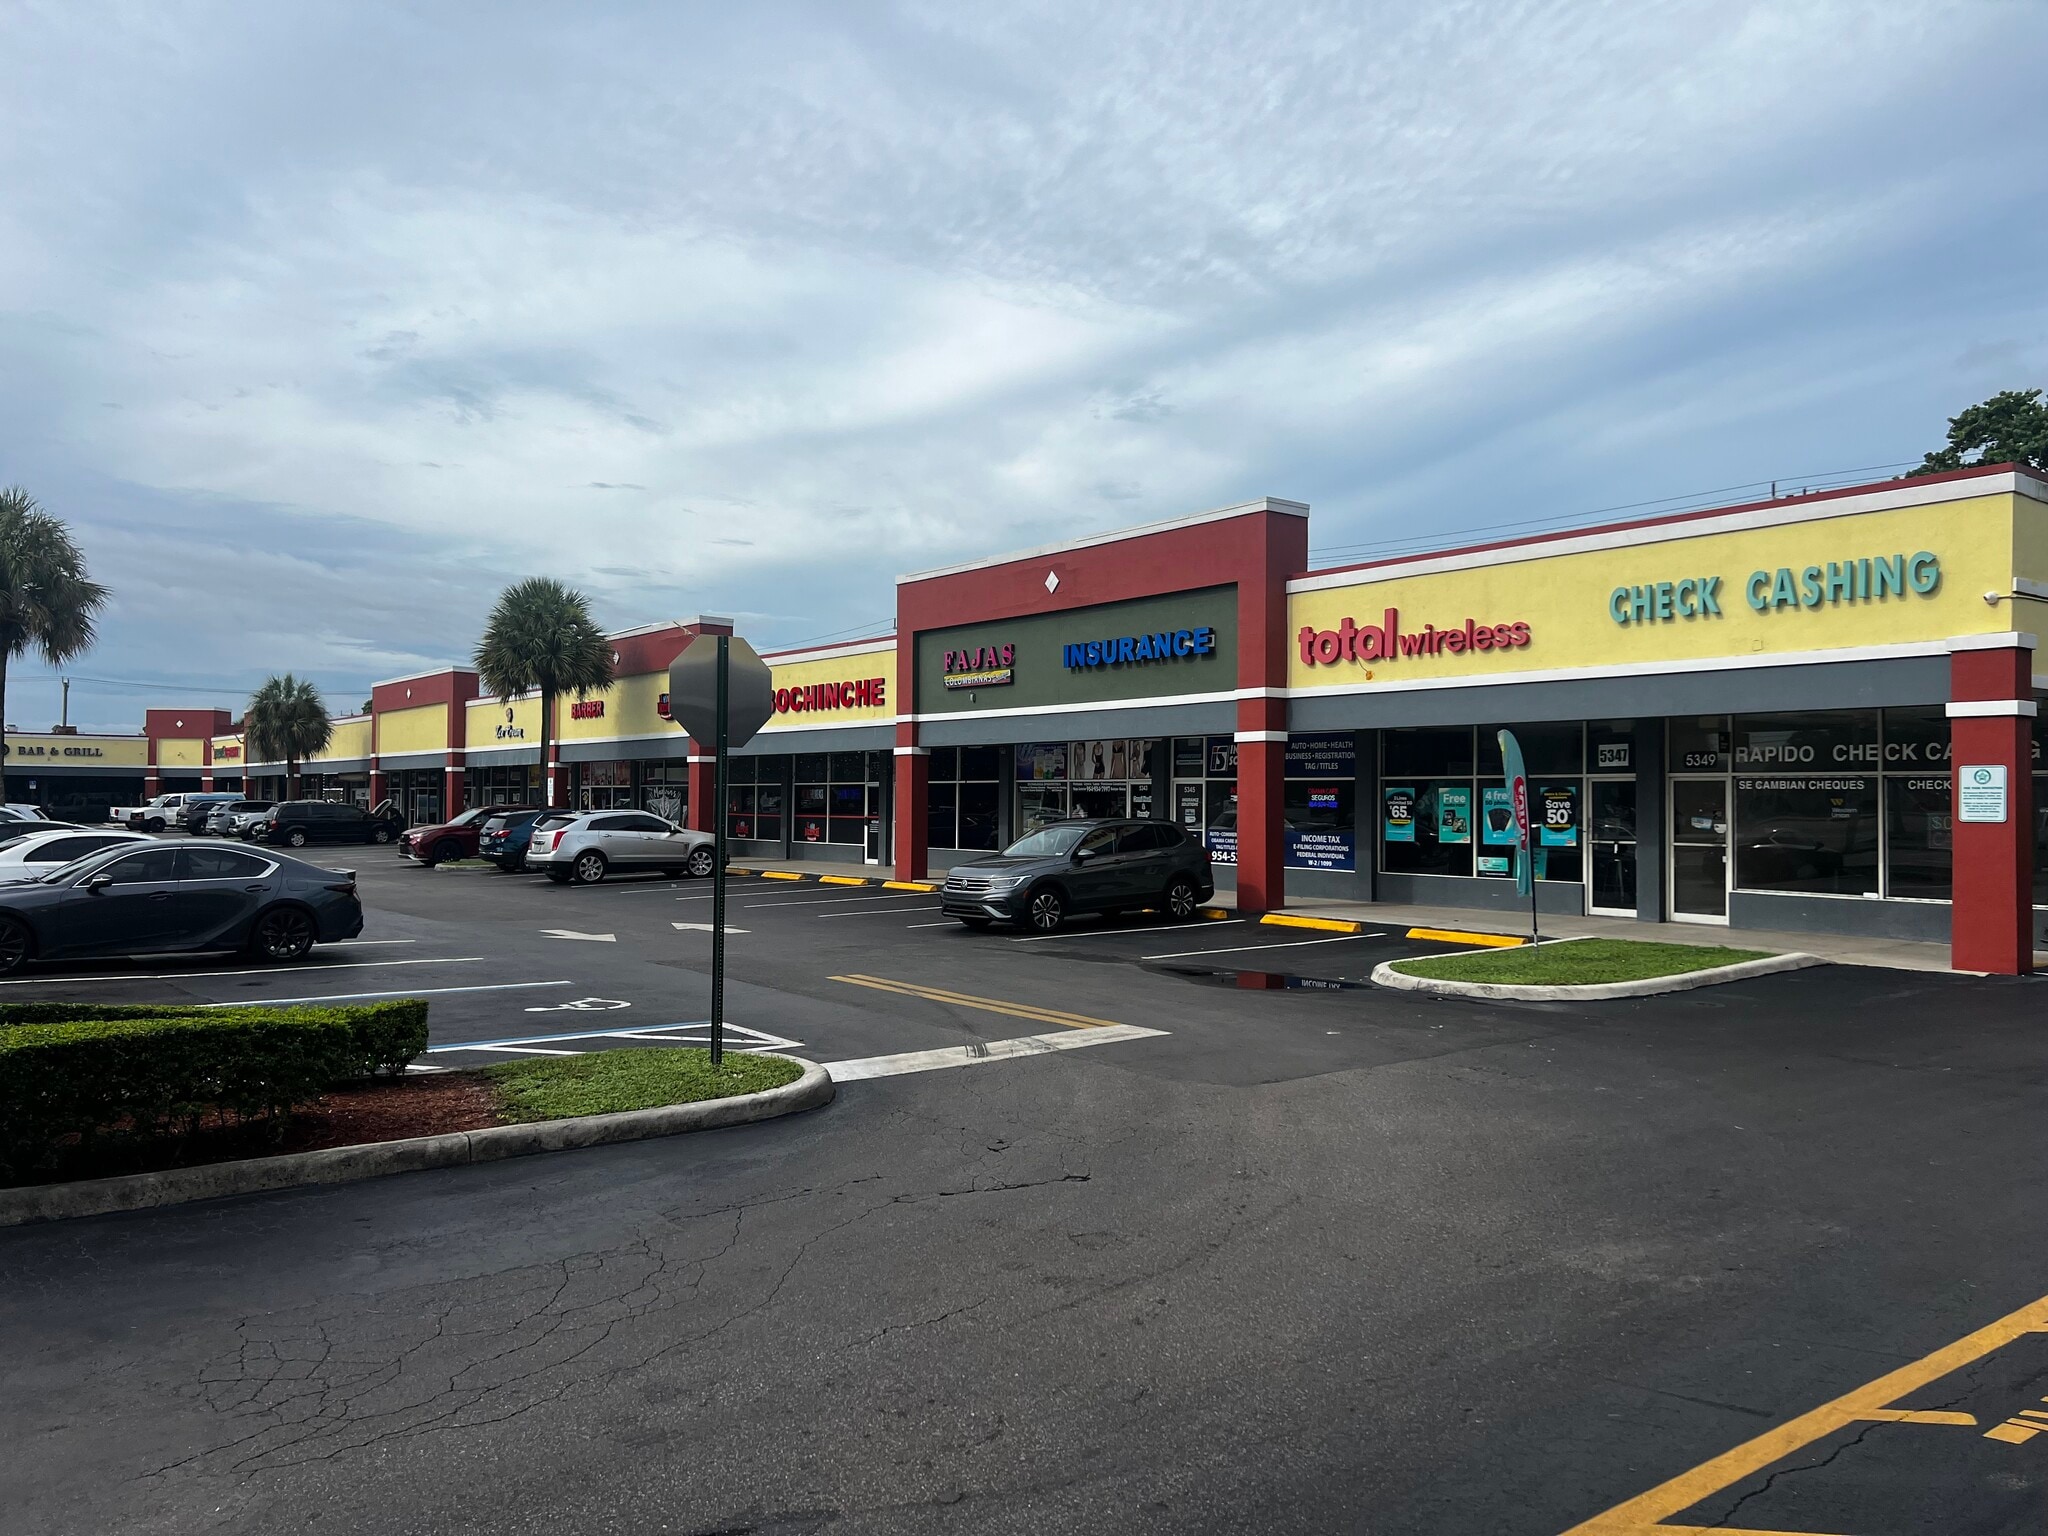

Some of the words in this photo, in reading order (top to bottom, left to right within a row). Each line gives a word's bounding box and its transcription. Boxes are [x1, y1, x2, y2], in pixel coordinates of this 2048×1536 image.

[1609, 576, 1721, 623] CHECK
[1746, 550, 1940, 611] CASHING
[1298, 608, 1398, 665] total
[1398, 618, 1531, 656] wireless
[1063, 627, 1212, 668] INSURANCE
[943, 643, 1015, 672] FAJAS
[945, 674, 992, 687] COLOMBIANAS
[571, 700, 604, 719] BARBER
[18, 746, 45, 756] BAR
[50, 747, 59, 756] &
[64, 747, 103, 757] GRILL
[1600, 749, 1627, 762] 5347
[1735, 745, 1815, 763] RAPIDO
[1832, 743, 1918, 762] CHECK
[1685, 754, 1716, 766] 5349
[1738, 780, 1753, 790] SE
[1755, 780, 1806, 790] CAMBIAN
[1808, 780, 1865, 790] CHEQUES
[1443, 793, 1466, 803] Free
[1485, 791, 1492, 799] 4
[1493, 790, 1508, 800] fre
[1545, 800, 1571, 809] Save
[1301, 834, 1327, 843] INCOME
[1328, 835, 1341, 843] TAX
[1312, 844, 1349, 852] CORPORATIONS
[1211, 850, 1238, 862] 954-5
[1317, 852, 1345, 860] INDIVIDUAL
